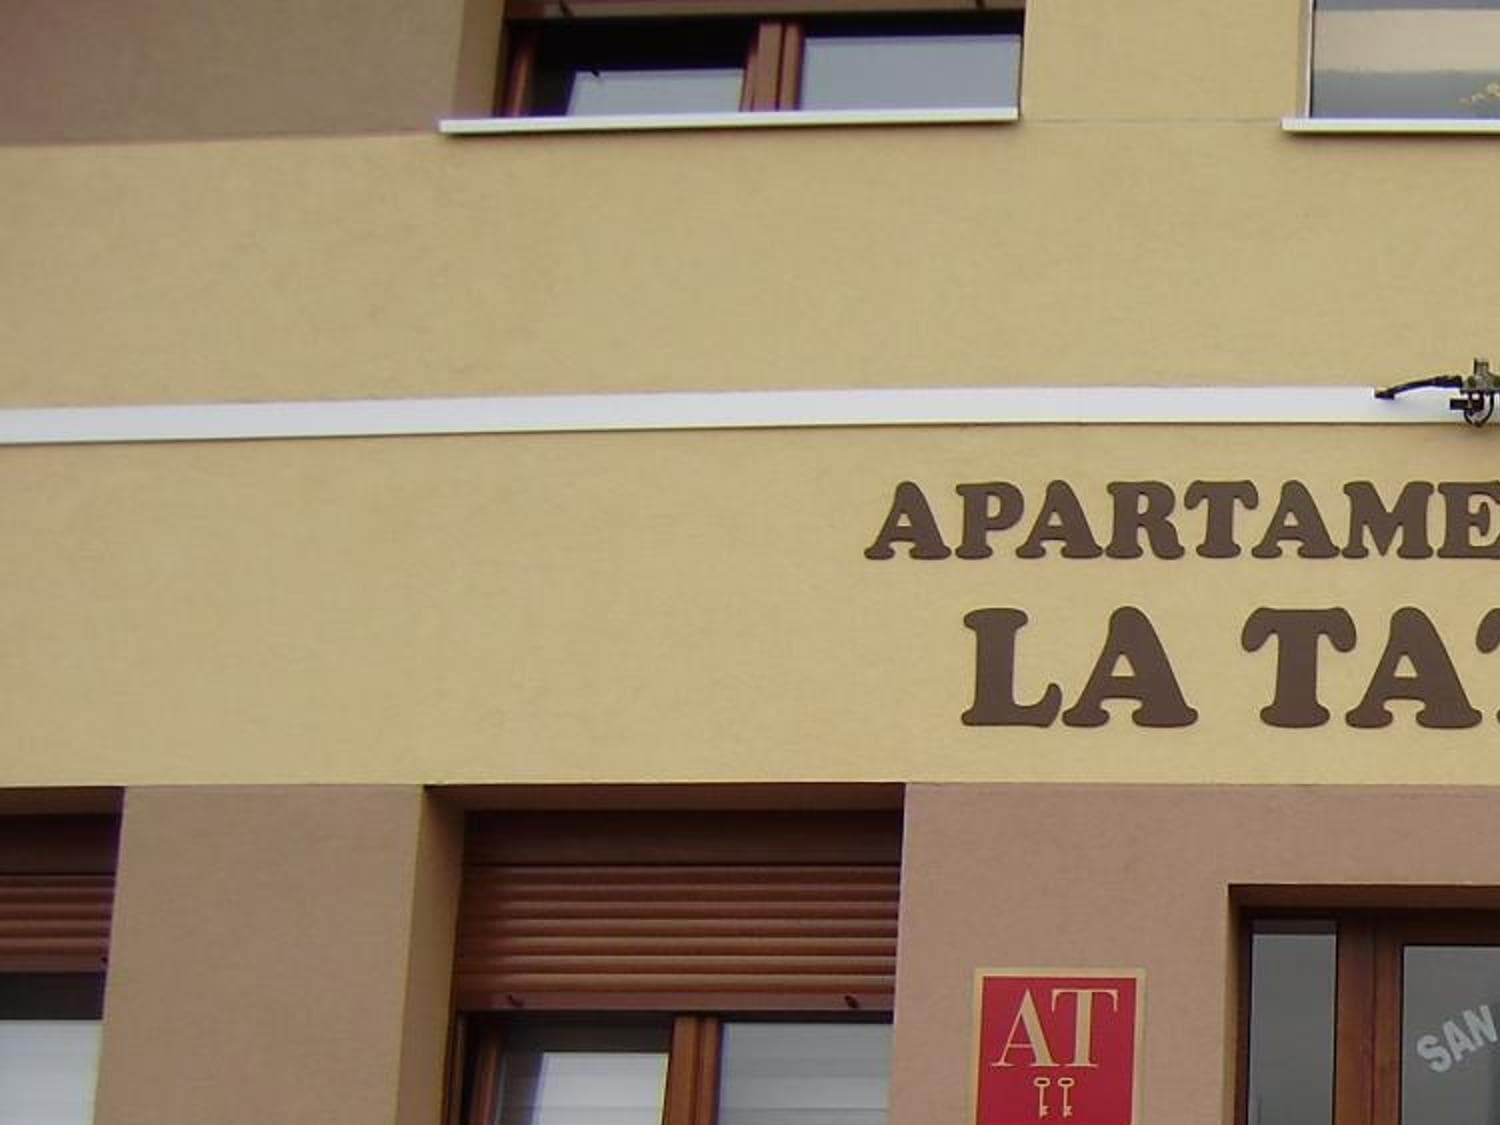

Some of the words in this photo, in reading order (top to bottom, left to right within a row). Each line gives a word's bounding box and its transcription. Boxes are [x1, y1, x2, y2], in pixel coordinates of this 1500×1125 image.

[960, 605, 1199, 728] LA
[991, 988, 1119, 1067] AT
[1416, 1004, 1498, 1073] SAN
